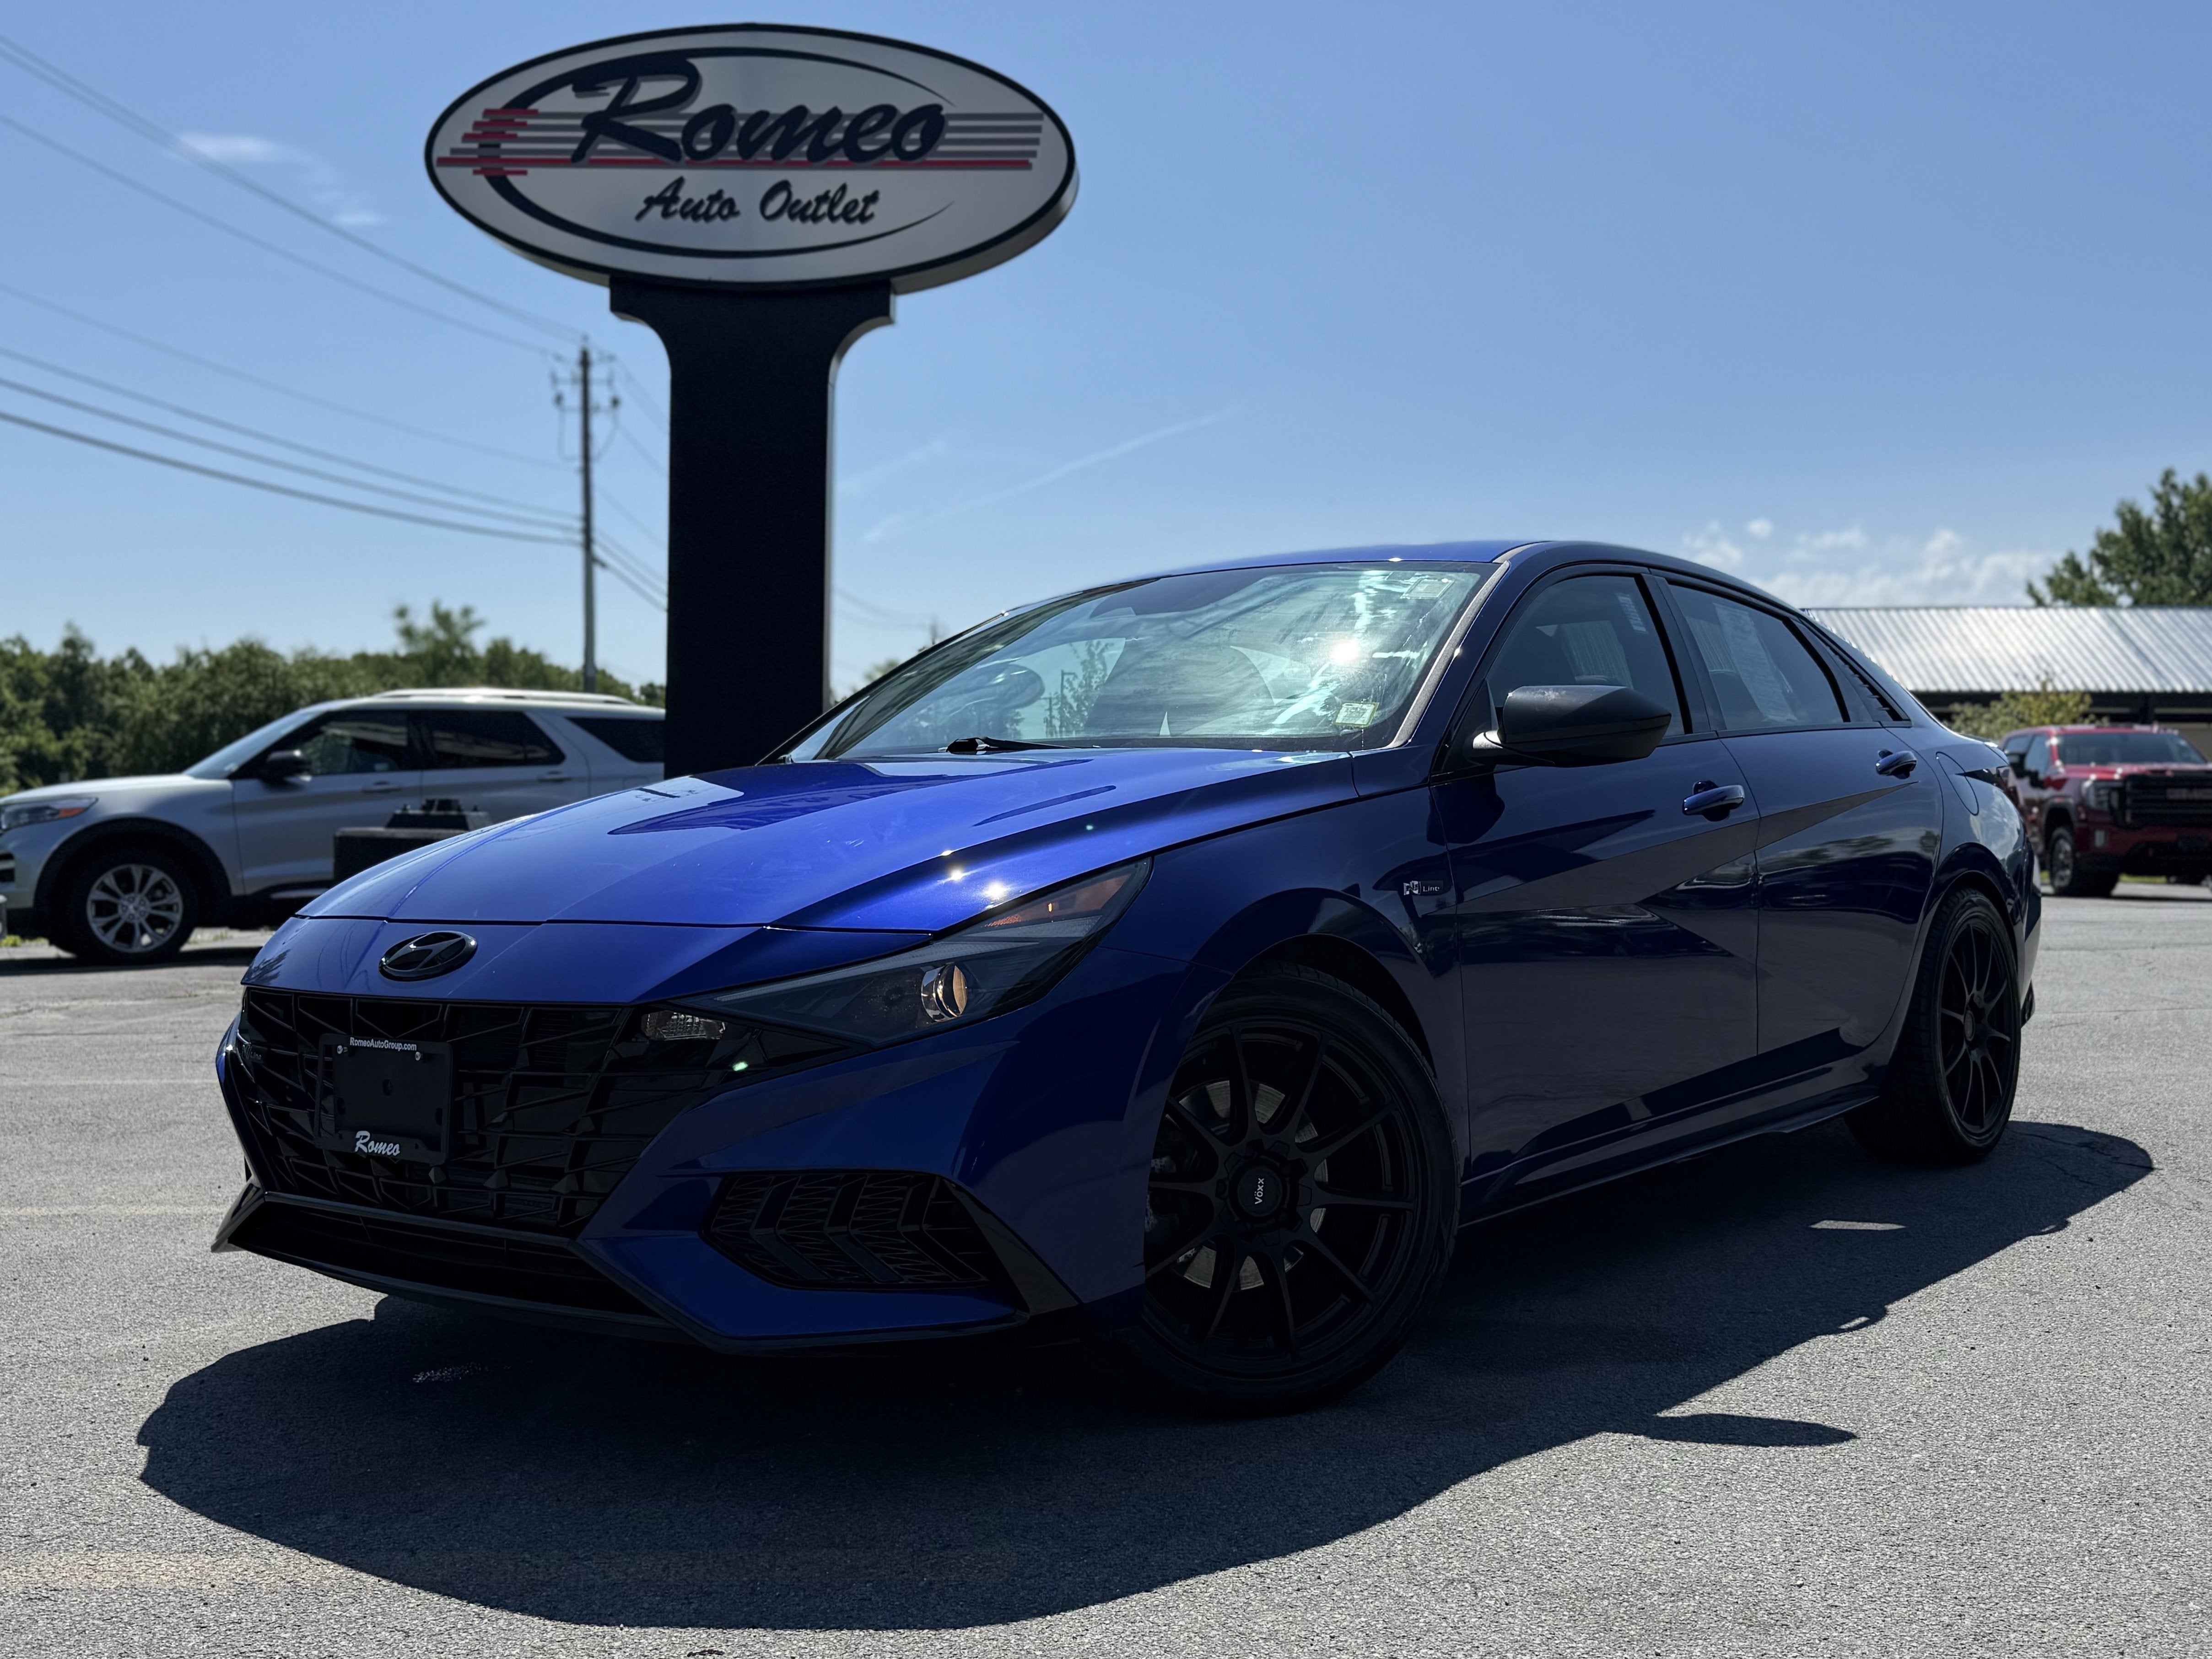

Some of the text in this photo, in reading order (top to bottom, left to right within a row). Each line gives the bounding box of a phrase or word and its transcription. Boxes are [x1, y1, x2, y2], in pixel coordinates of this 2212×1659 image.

[571, 56, 945, 163] Romeo
[636, 177, 879, 222] Auto Outlet
[350, 1037, 417, 1051] RomeoAutoGroup.com
[355, 1131, 400, 1156] Romeo
